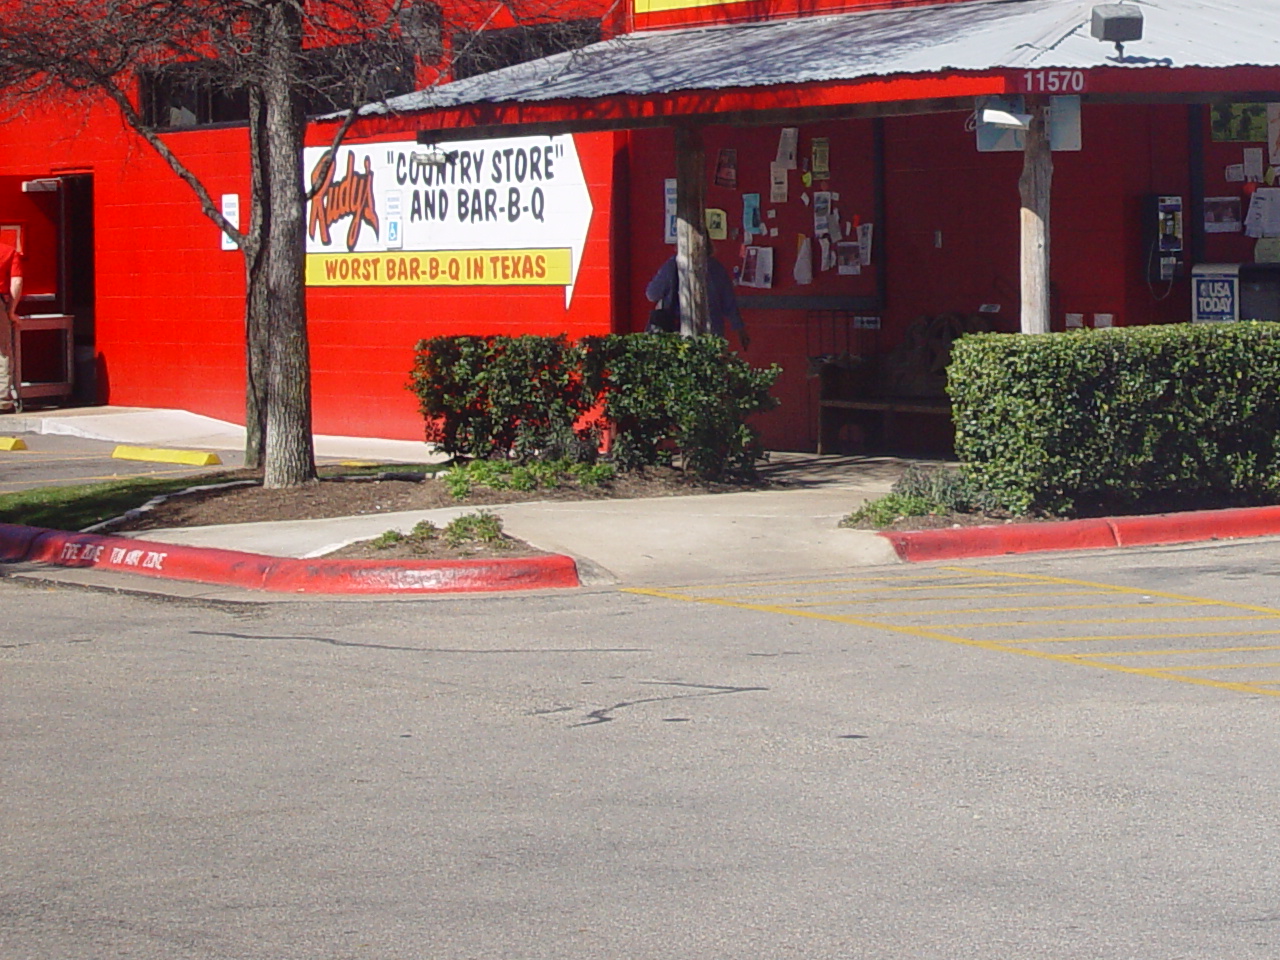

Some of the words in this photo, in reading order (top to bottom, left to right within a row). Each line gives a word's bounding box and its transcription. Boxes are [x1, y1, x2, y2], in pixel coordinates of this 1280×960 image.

[1023, 70, 1084, 92] 11570
[491, 143, 565, 183] STORE"
[308, 149, 380, 253] Rudy's
[410, 187, 449, 224] AND
[457, 186, 545, 224] BAR-B-Q
[325, 257, 381, 281] WORST
[386, 256, 461, 282] BAR-B-Q
[466, 256, 484, 279] IN
[490, 254, 546, 279] TEXAS
[1208, 282, 1232, 298] USA
[1198, 297, 1232, 313] TODAY
